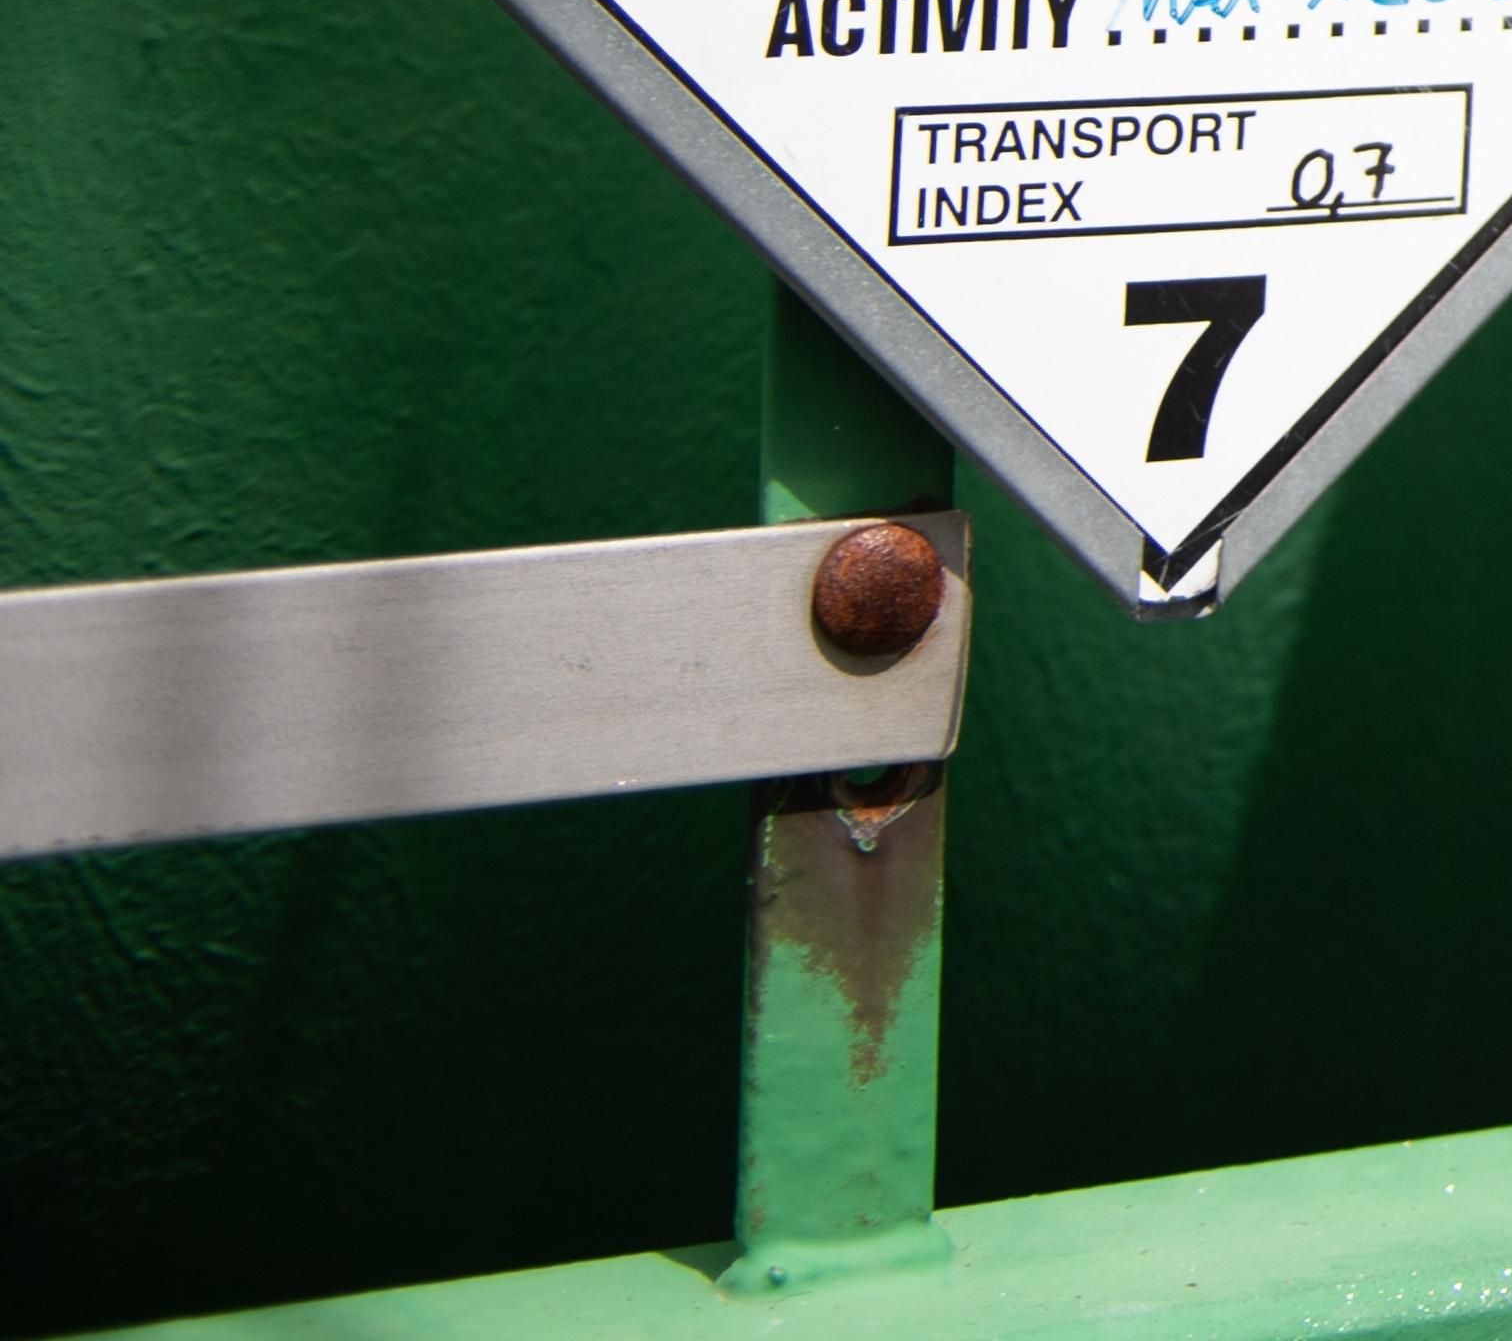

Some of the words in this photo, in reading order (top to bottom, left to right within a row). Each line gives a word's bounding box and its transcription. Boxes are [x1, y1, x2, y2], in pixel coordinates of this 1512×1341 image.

[917, 110, 1256, 165] TRANSPORT
[917, 180, 1084, 229] INDEX
[1291, 141, 1396, 217] 0,7
[1123, 274, 1267, 464] 7
